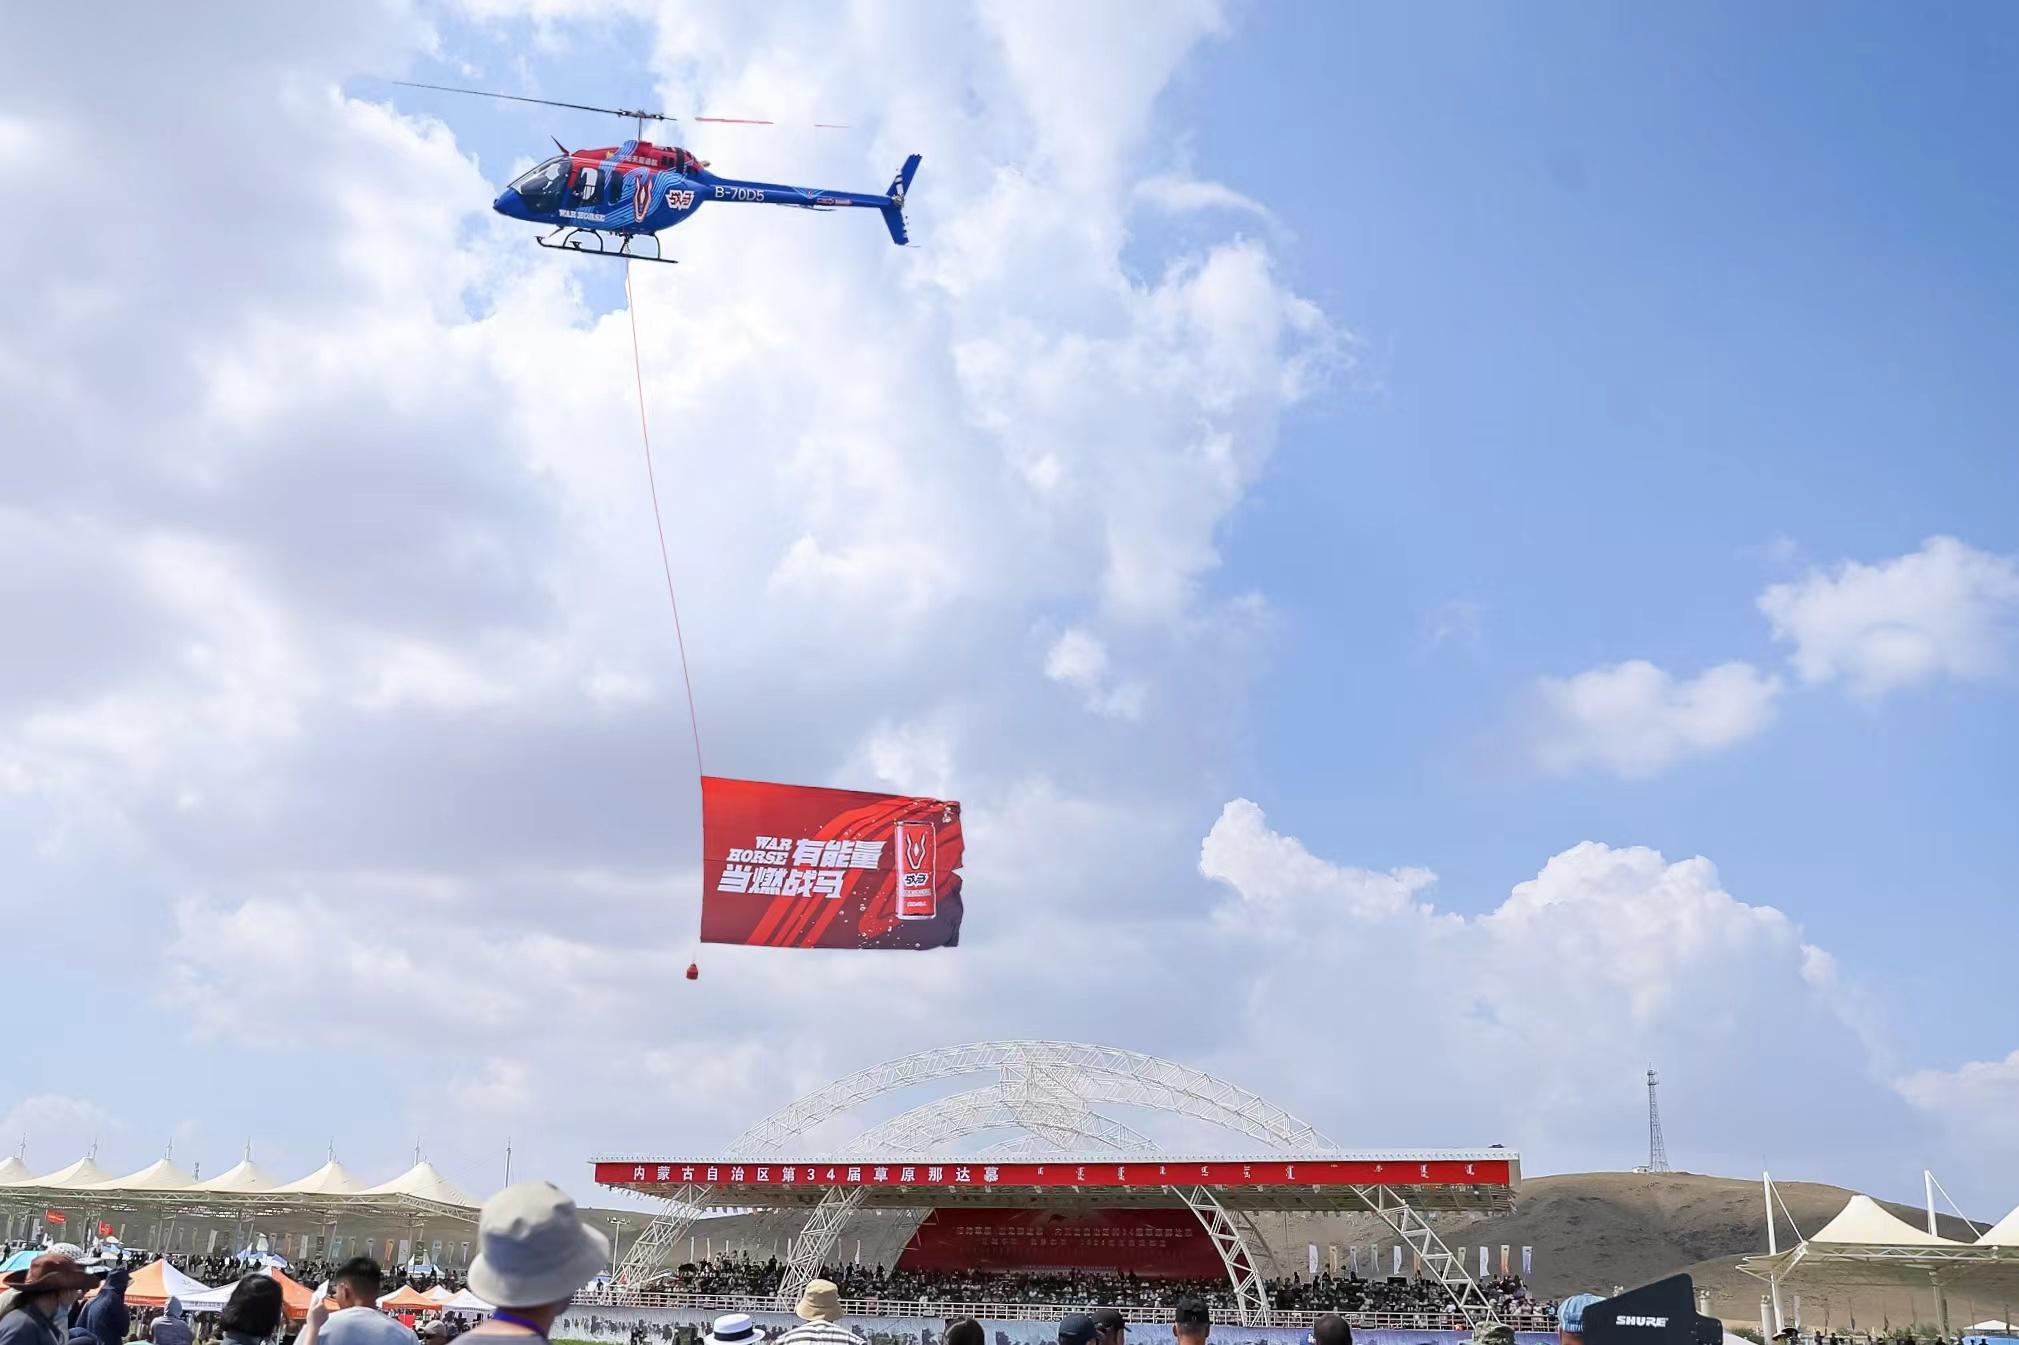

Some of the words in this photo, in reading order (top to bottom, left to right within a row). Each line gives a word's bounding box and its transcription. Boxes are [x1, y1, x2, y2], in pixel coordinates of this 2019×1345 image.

[715, 186, 765, 201] B-70D5
[559, 209, 577, 219] WAR
[577, 211, 606, 222] HORSE
[755, 836, 793, 850] WAR
[726, 848, 789, 865] HORSE
[792, 838, 887, 870] 有能量
[717, 863, 846, 898] 当燃战马
[633, 1165, 999, 1183] 内蒙古自治区第34届草原那达慕
[1616, 1315, 1667, 1328] SHURE
